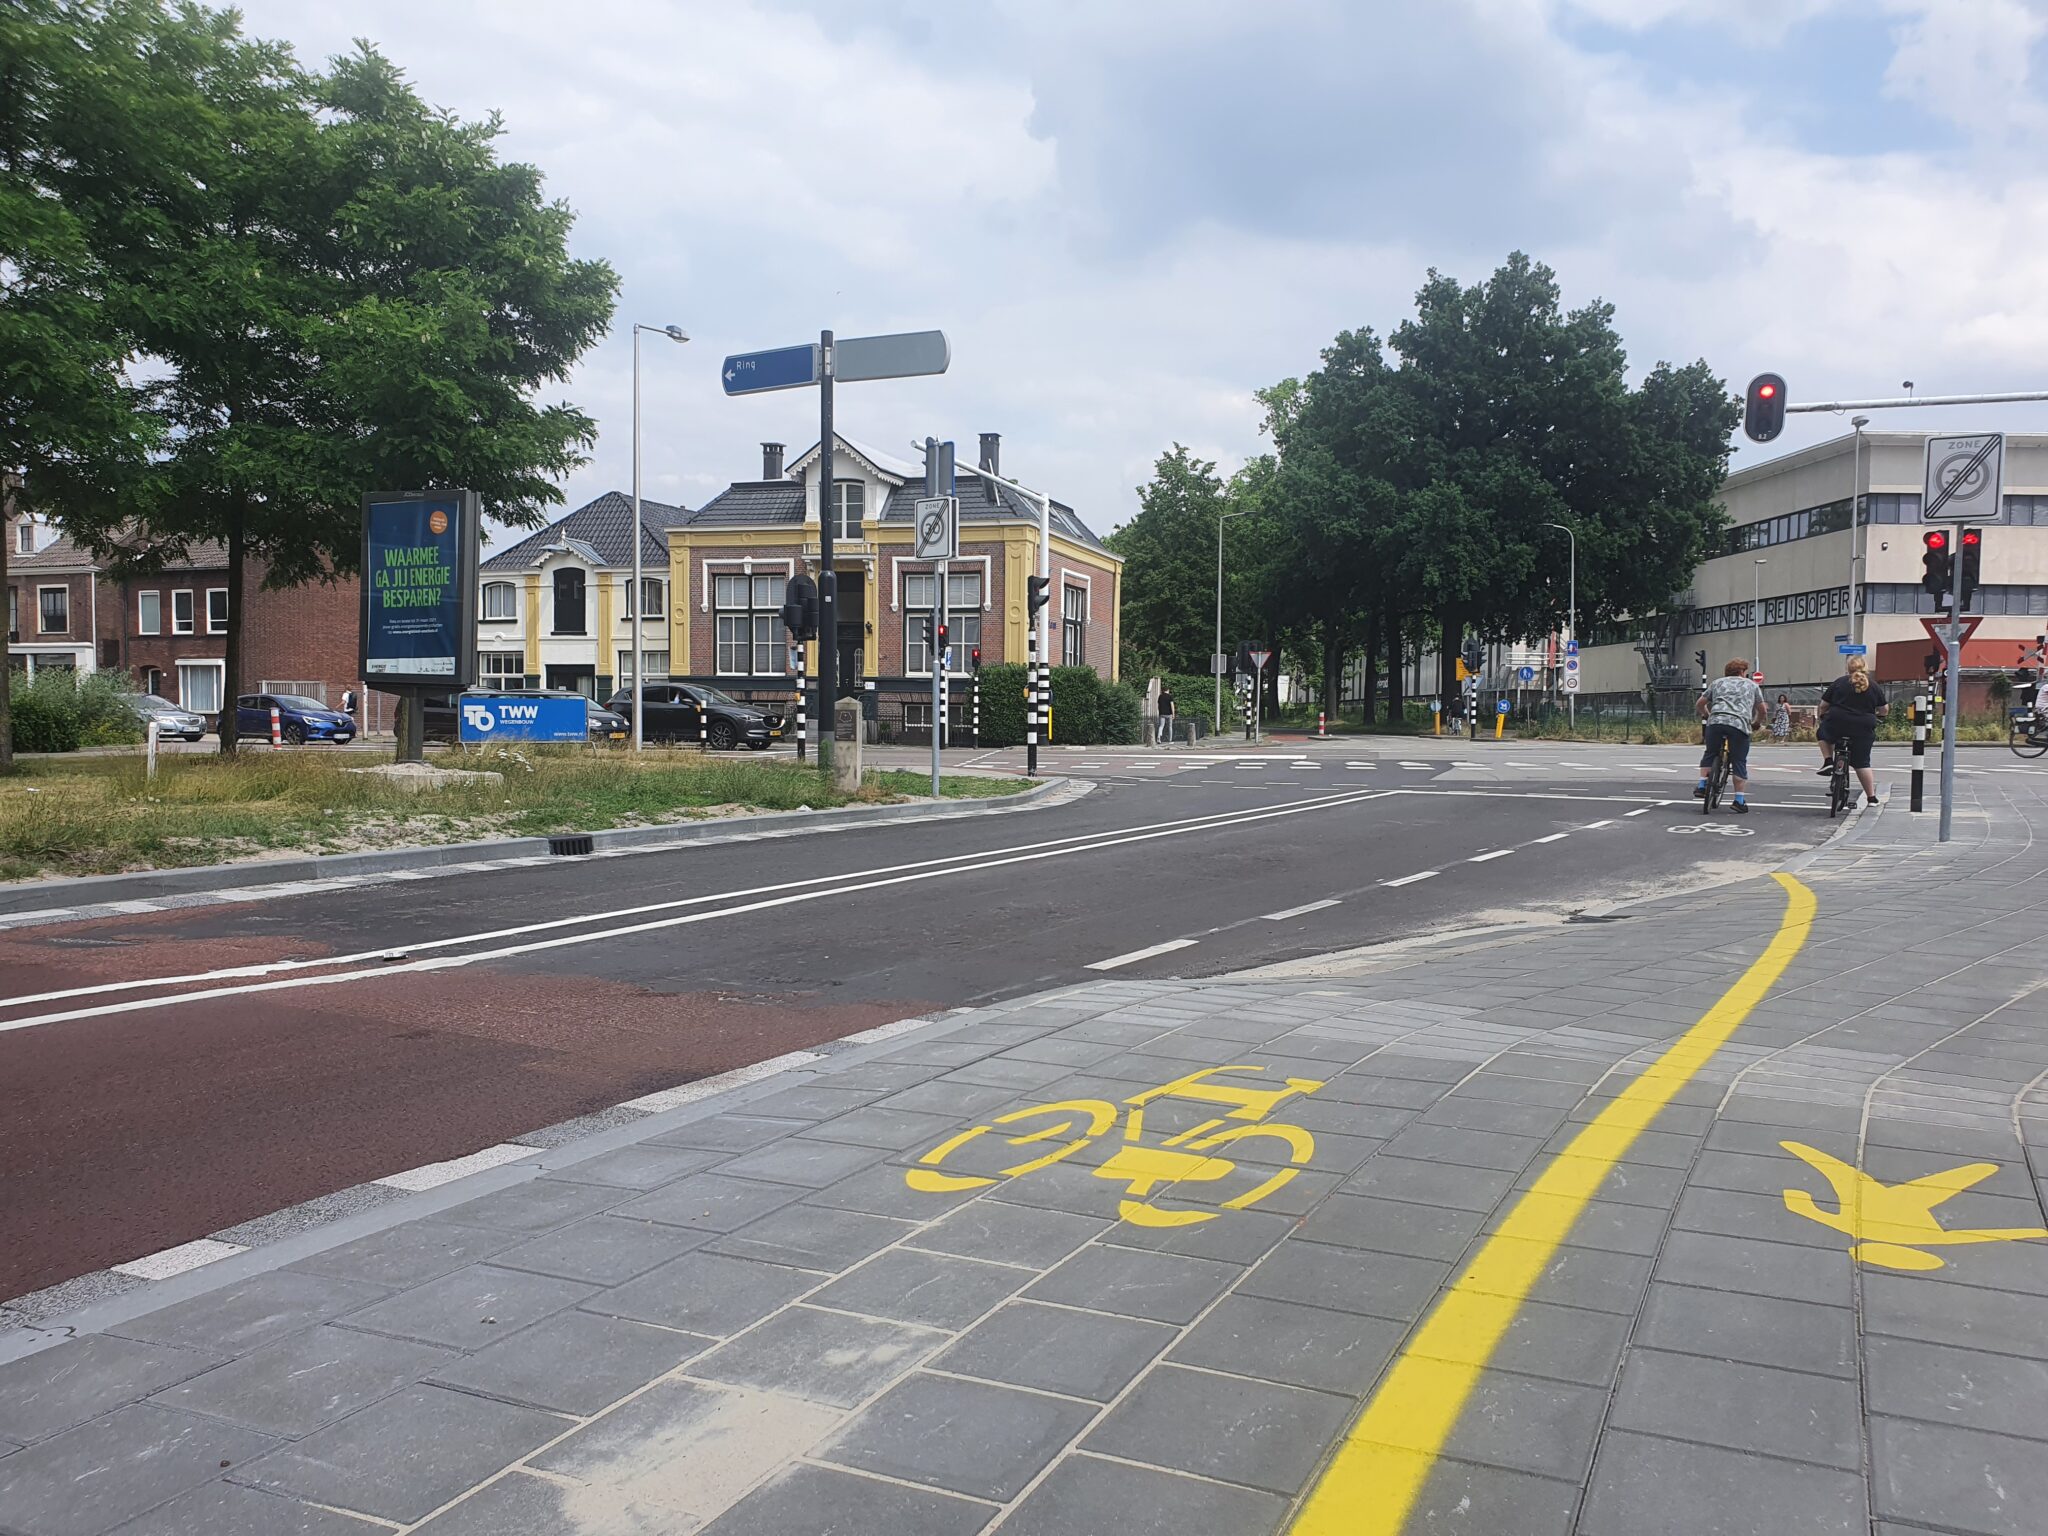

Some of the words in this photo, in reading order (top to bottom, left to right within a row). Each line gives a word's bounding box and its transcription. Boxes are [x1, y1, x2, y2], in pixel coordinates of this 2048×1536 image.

[736, 361, 756, 371] Ring
[1948, 440, 1981, 449] ZONE
[1945, 468, 1981, 485] 30
[384, 546, 439, 567] WAARMEE
[375, 569, 390, 588] GA
[392, 568, 408, 587] JIJ
[410, 566, 451, 587] ENERGIE
[383, 587, 442, 608] BESPAREN?
[498, 705, 539, 719] TWW
